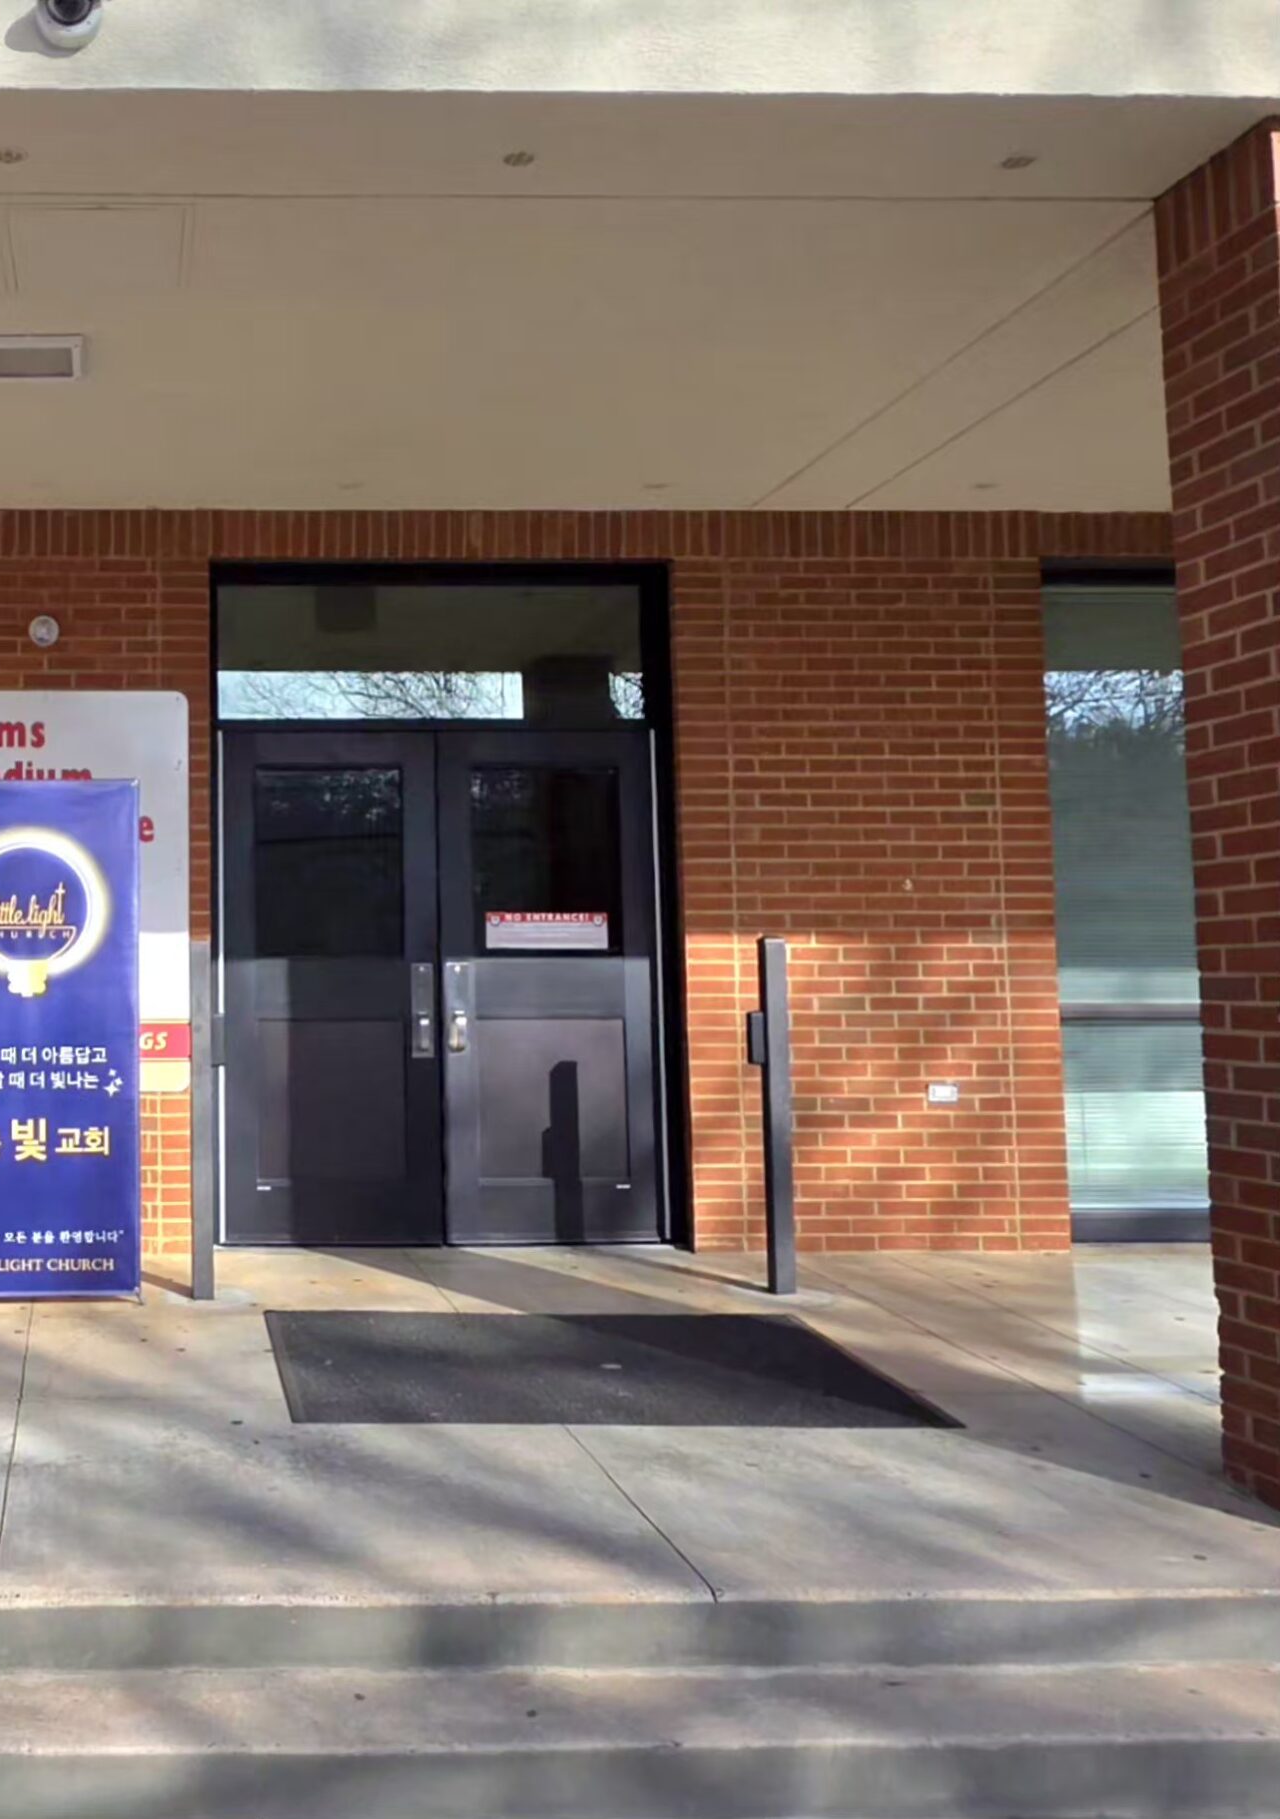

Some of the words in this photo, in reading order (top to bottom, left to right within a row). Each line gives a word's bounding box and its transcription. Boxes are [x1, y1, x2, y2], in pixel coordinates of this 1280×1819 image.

[504, 913, 523, 922] NO
[526, 912, 589, 922] ENTRANCE!
[0, 1047, 17, 1065] 때
[21, 1047, 37, 1065] 더
[42, 1047, 108, 1065] 아름답고
[8, 1071, 26, 1090] 때
[29, 1071, 46, 1090] 더
[50, 1071, 100, 1090] 빛나는
[11, 1117, 48, 1162] 빛
[54, 1126, 110, 1156] 교회
[46, 1257, 115, 1272] CHURCH
